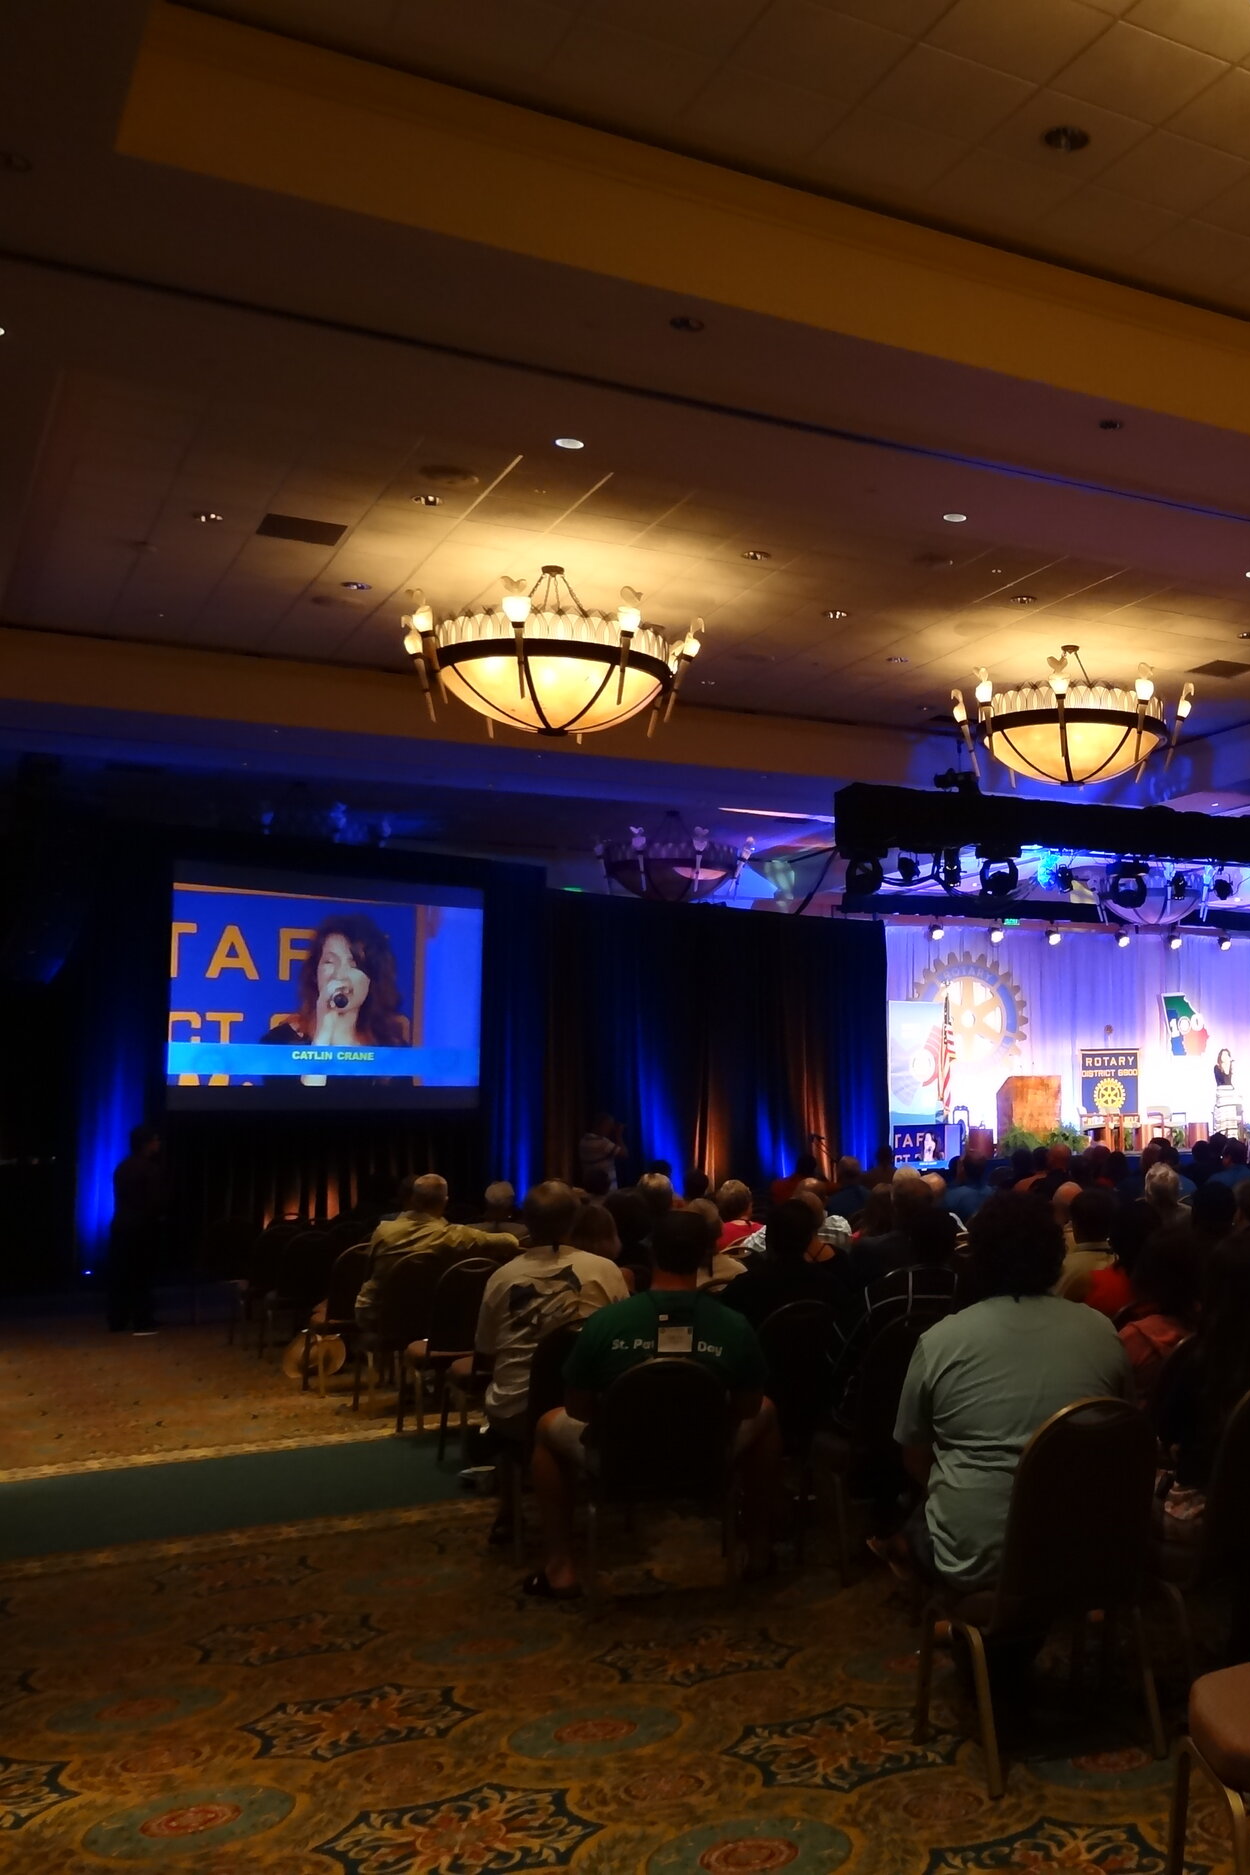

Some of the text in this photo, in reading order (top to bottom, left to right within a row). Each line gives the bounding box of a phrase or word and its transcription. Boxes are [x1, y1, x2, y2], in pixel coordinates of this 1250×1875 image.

[291, 1050, 375, 1061] CATLIN CRANE
[1085, 1056, 1135, 1067] ROTARY
[1081, 1069, 1116, 1077] DISTRICT
[611, 1339, 629, 1350] St.
[697, 1341, 723, 1356] Day
